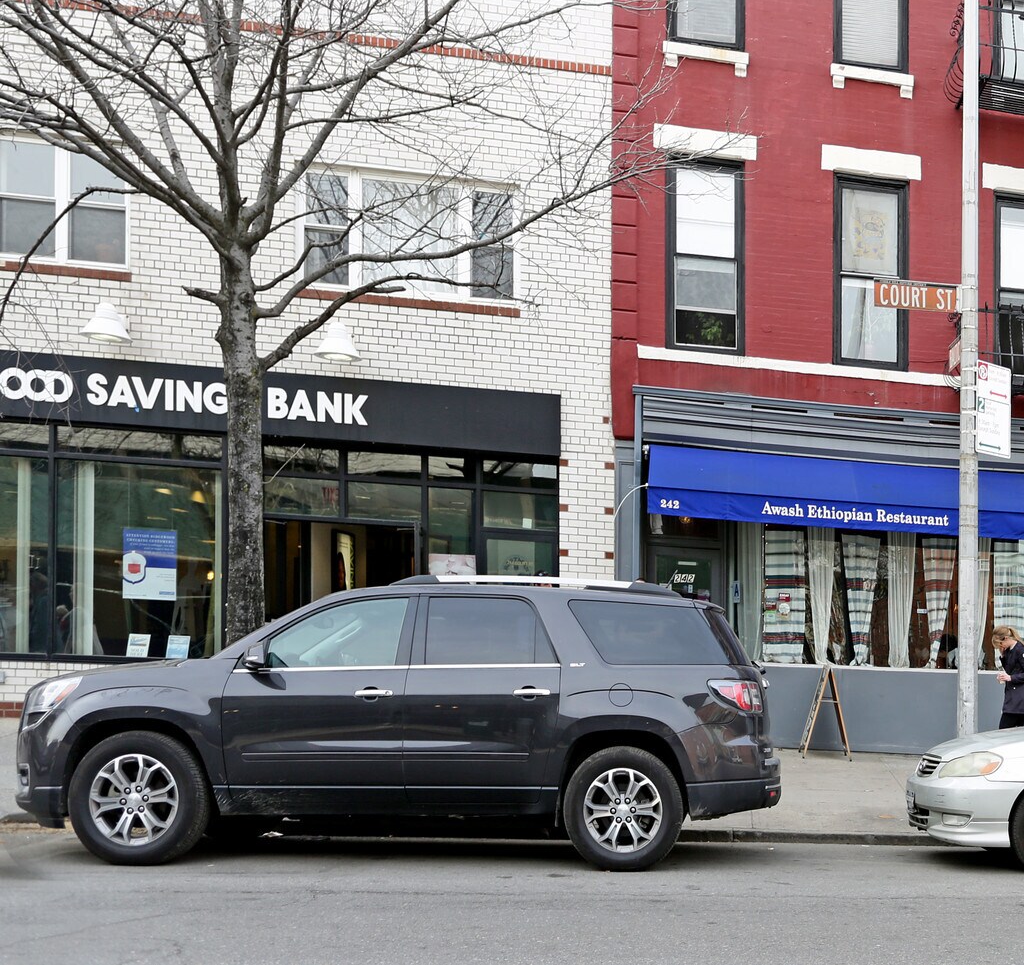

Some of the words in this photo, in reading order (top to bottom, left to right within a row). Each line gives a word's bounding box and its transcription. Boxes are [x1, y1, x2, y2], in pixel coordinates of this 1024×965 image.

[880, 284, 928, 309] COURT
[936, 288, 953, 311] ST
[86, 372, 229, 414] SAVING
[267, 387, 369, 426] BANK
[660, 498, 681, 510] 242
[761, 501, 804, 518] Awash
[808, 504, 873, 523] Ethiopian
[876, 508, 950, 527] Restaurant
[673, 573, 696, 584] 242
